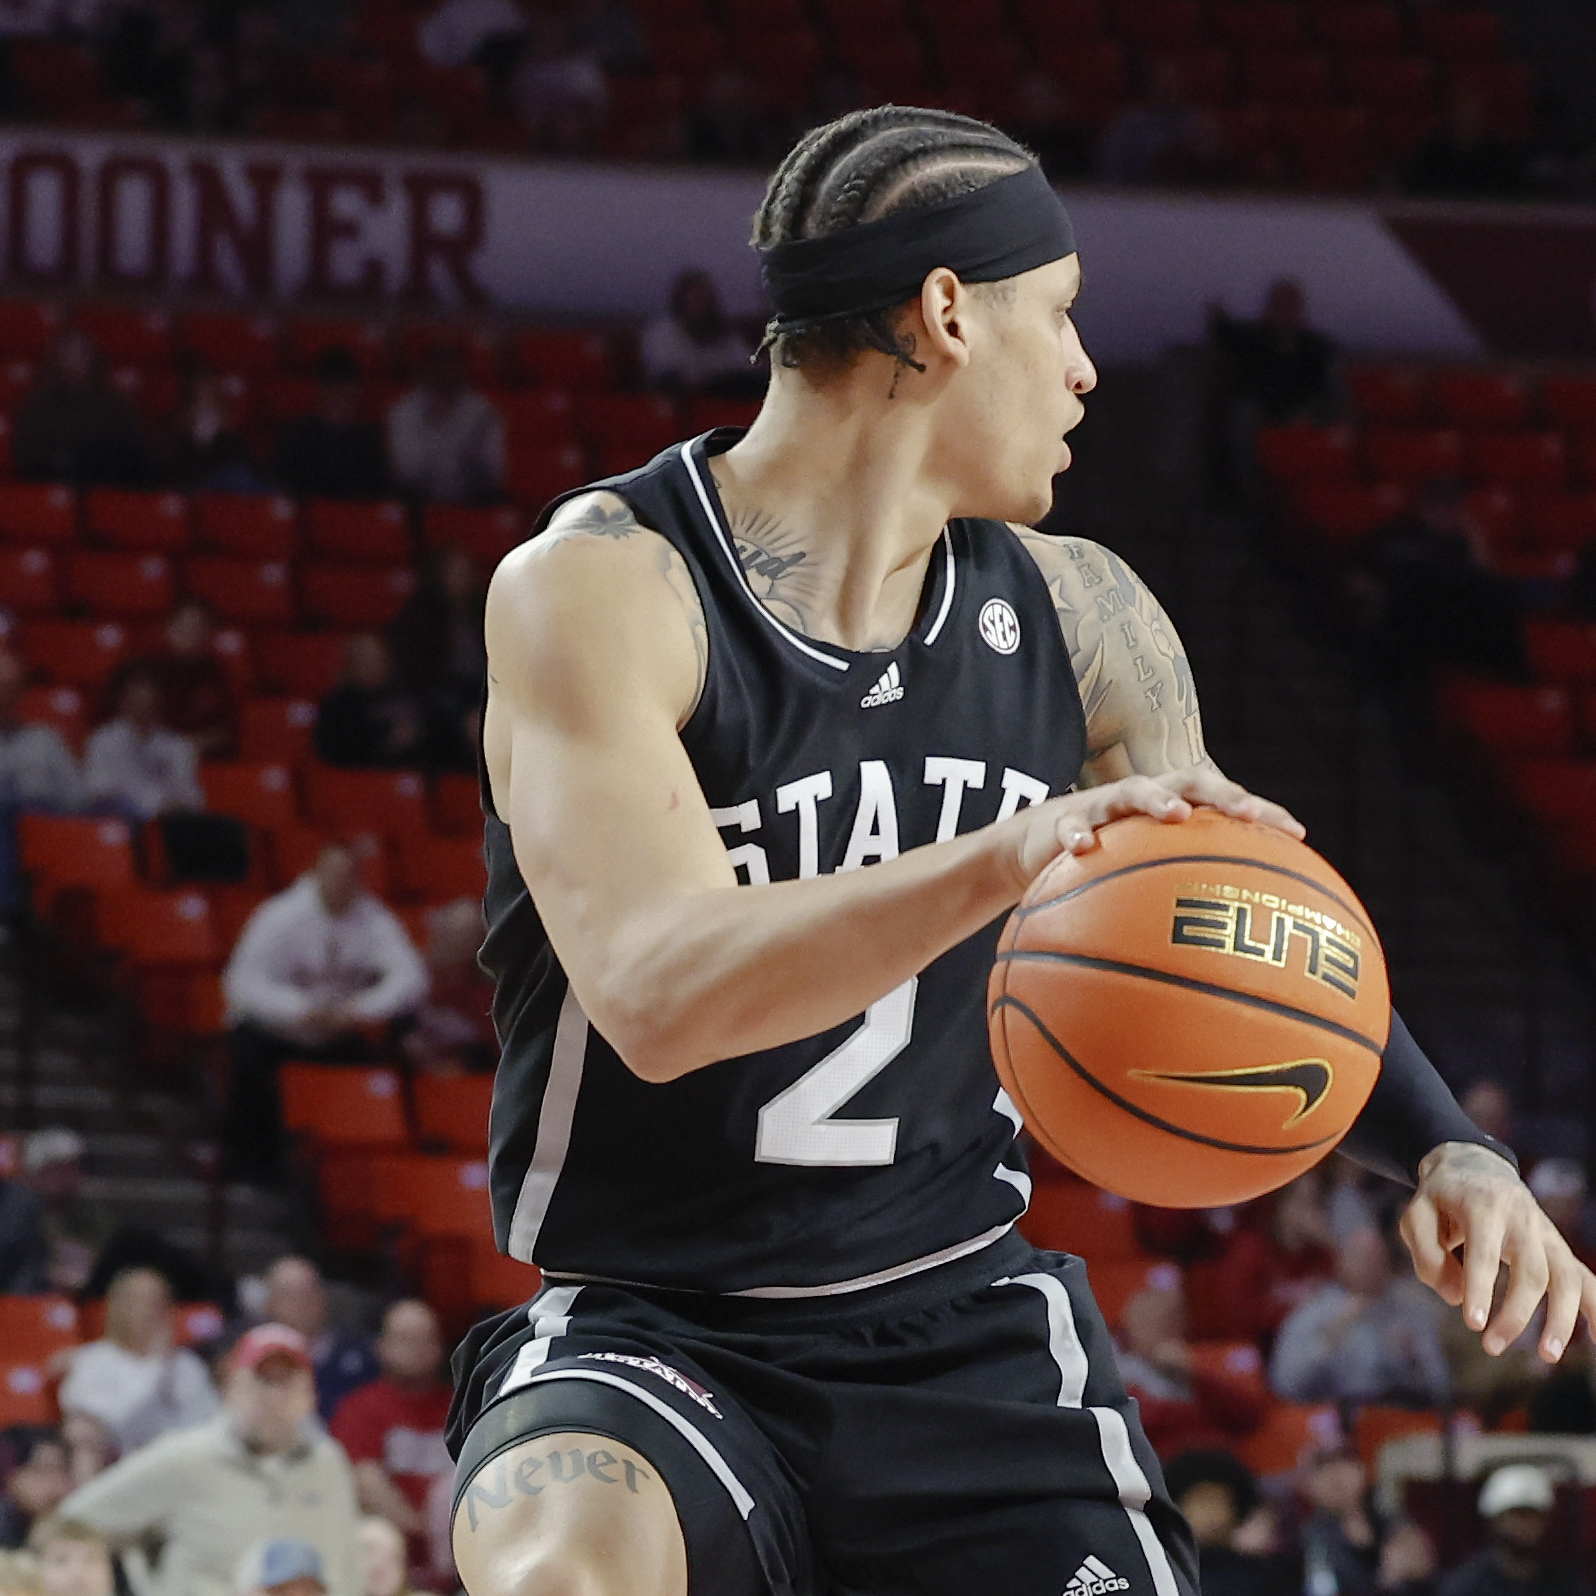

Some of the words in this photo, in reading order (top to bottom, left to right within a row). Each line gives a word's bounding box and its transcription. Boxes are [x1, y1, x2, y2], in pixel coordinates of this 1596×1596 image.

[981, 601, 1019, 651] SEC
[860, 685, 905, 709] adidas
[1170, 896, 1362, 1002] ELITE
[1173, 881, 1362, 948] CHAMPIONSH
[755, 975, 918, 1167] 2
[465, 1448, 651, 1534] Never
